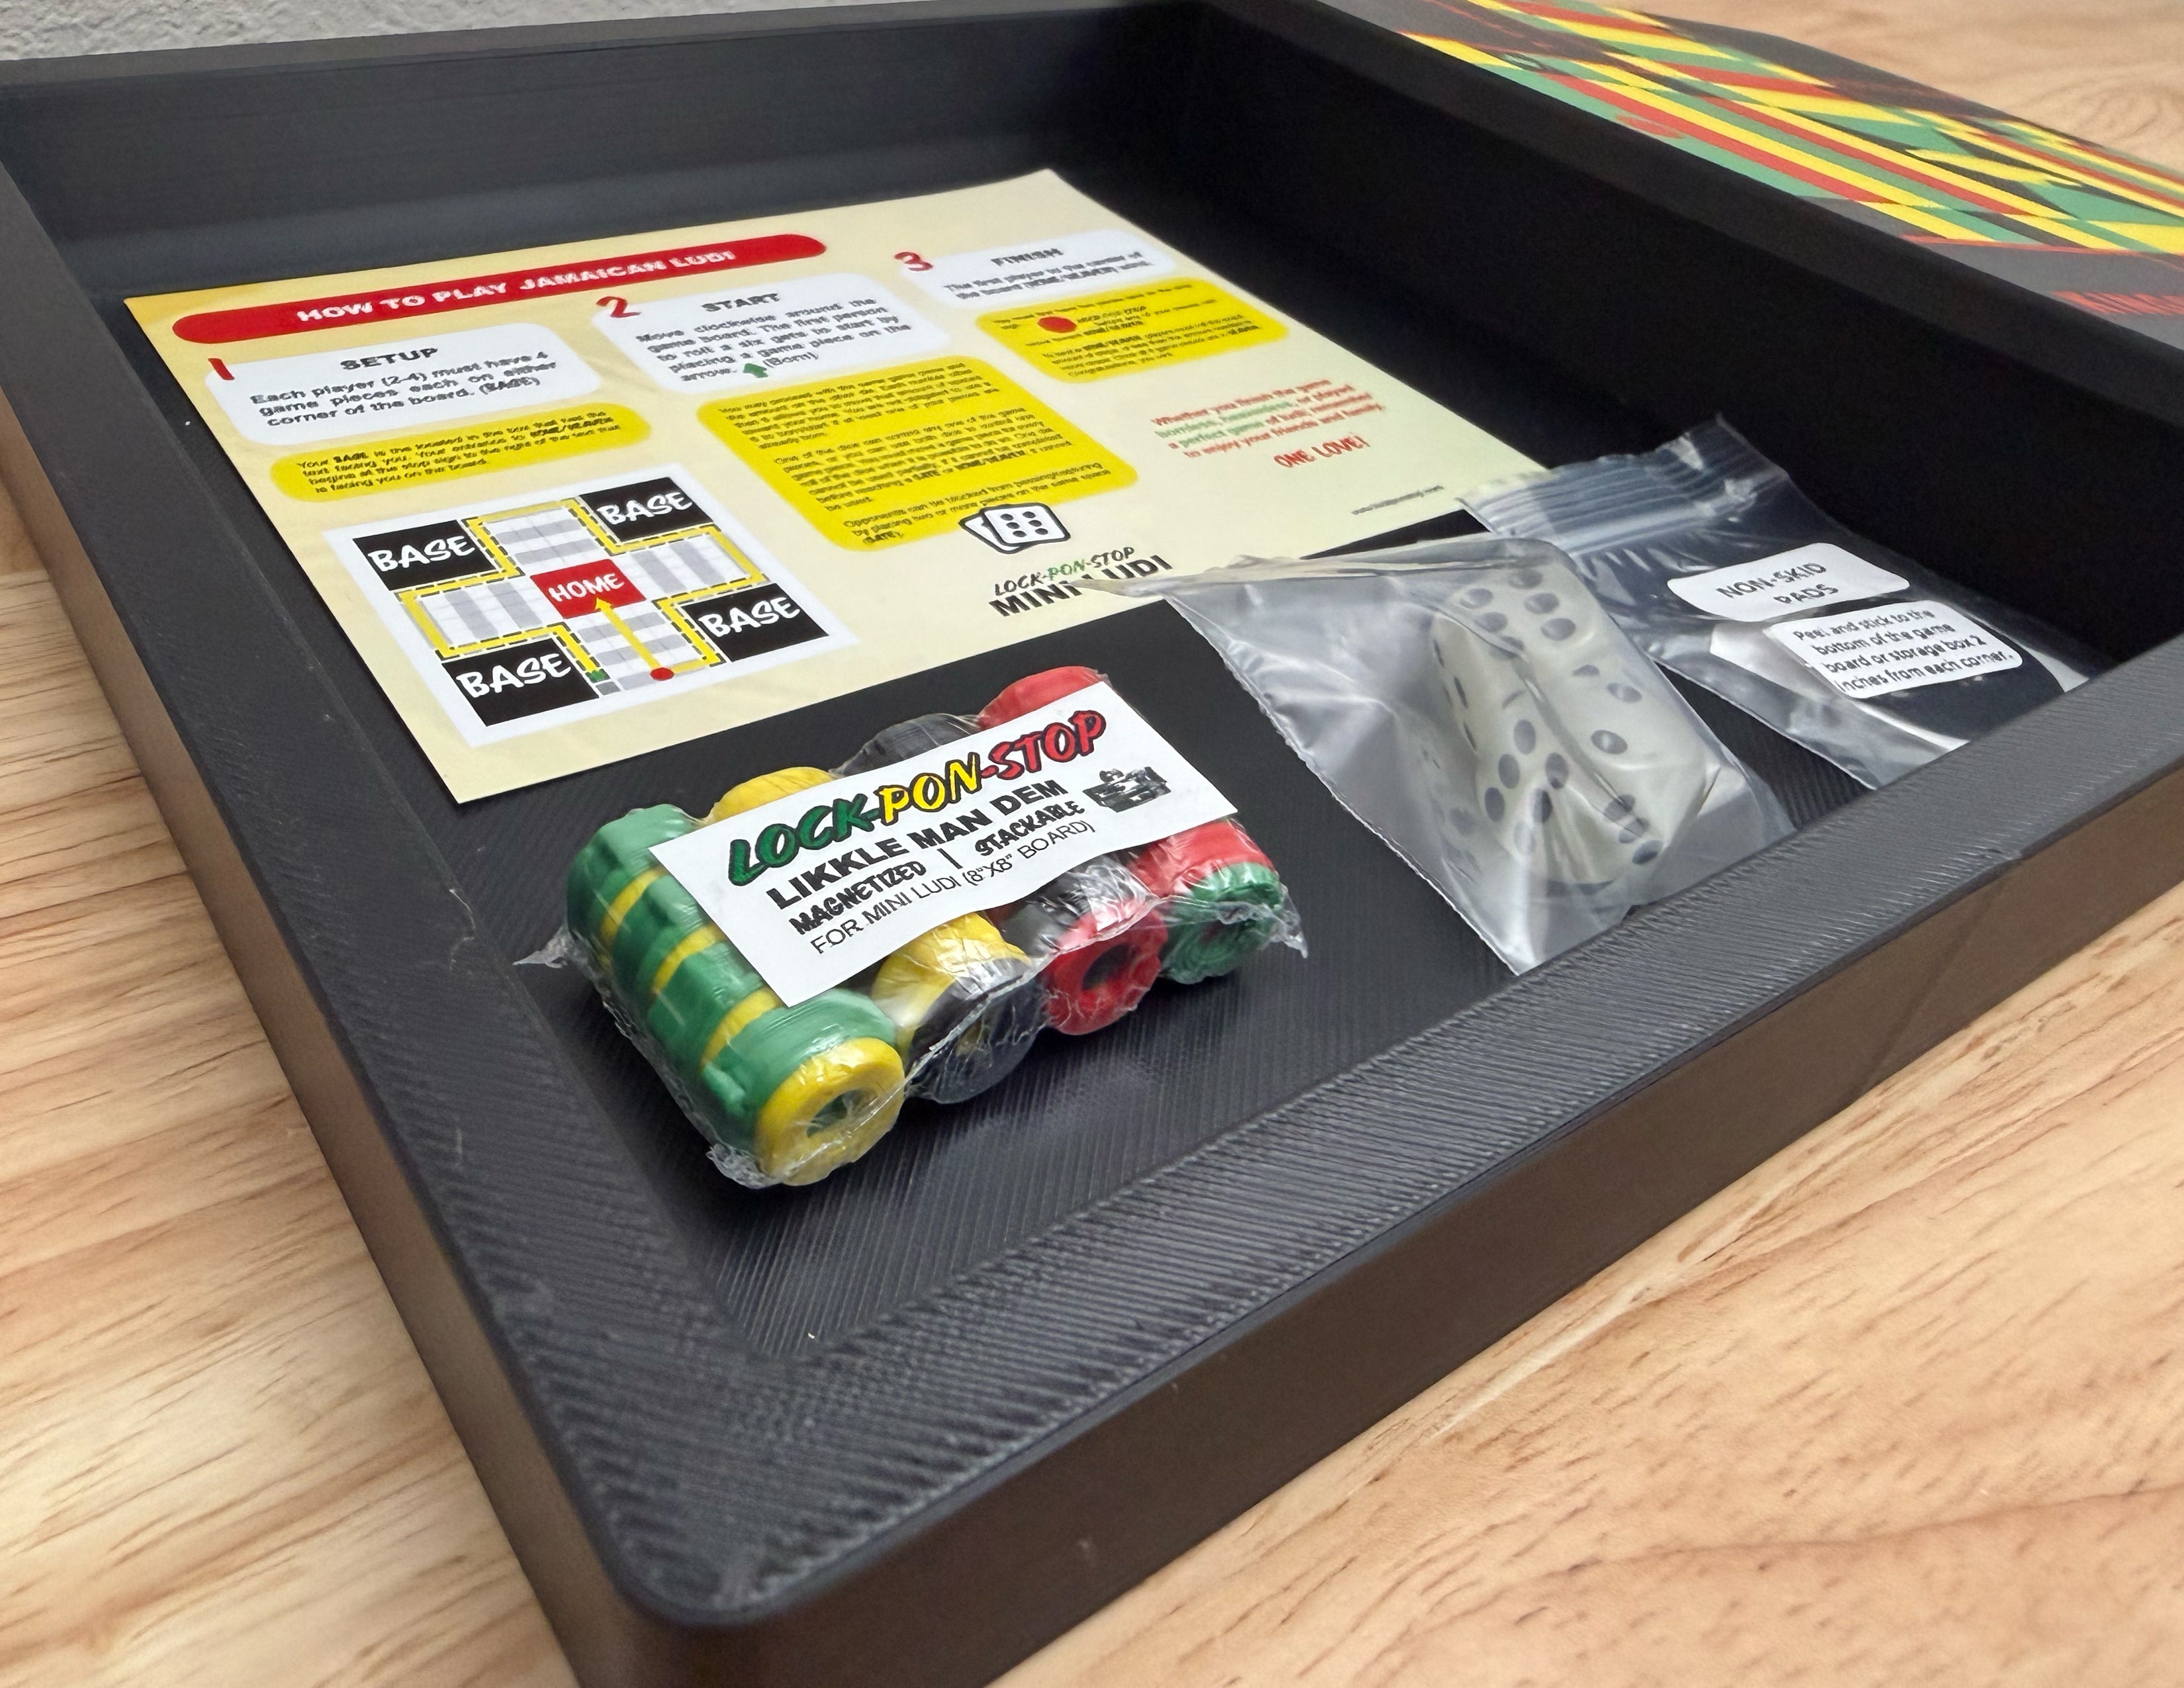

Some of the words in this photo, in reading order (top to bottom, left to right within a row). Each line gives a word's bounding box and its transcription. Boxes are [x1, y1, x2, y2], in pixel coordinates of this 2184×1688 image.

[894, 252, 933, 271] 3
[297, 302, 373, 321] HOW
[379, 295, 426, 309] TO
[432, 282, 506, 302] PLAY
[520, 260, 667, 290] JAMAICAN
[669, 251, 737, 267] LUDI
[702, 293, 780, 312] START
[596, 296, 641, 318] 2
[340, 348, 437, 370] SETUP
[250, 391, 306, 404] Each
[311, 381, 374, 398] player
[381, 373, 427, 387] (2-4)
[432, 363, 482, 377] must
[484, 355, 532, 368] have
[259, 401, 318, 416] game
[330, 390, 399, 407] pieces
[409, 379, 459, 392] each
[468, 373, 494, 383] on
[504, 362, 556, 377] either
[267, 410, 338, 426] corner
[344, 405, 365, 414] of
[370, 401, 404, 410] the
[408, 388, 475, 405] board.
[479, 377, 540, 395] (BASE)
[1274, 449, 1315, 467] ONE
[1311, 436, 1370, 457] LOVE!
[596, 489, 692, 526] BASE
[368, 533, 475, 572] BASE
[995, 547, 1134, 596] LOCK-PON-STOP
[549, 572, 625, 603] HOME
[989, 581, 1083, 616] MINI
[1082, 555, 1173, 580] UDI
[1716, 562, 1827, 598] NON-SKID
[1774, 584, 1839, 604] PADS
[699, 597, 800, 638] BASE
[1792, 628, 1831, 641] Peel
[1829, 622, 1860, 634] and
[1858, 616, 1893, 630] stick
[1890, 614, 1910, 623] to
[1907, 610, 1935, 620] the
[1810, 639, 1872, 655] bottom
[1869, 632, 1888, 645] of
[1885, 631, 1914, 641] the
[1912, 624, 1956, 639] game
[1821, 655, 1872, 673] board
[1870, 653, 1890, 664] or
[1888, 643, 1946, 661] storage
[1940, 638, 1976, 650] box
[1970, 635, 1987, 645] 2
[457, 653, 570, 698] BASE
[1884, 668, 1926, 682] from
[1923, 659, 1963, 675] each
[1959, 651, 2014, 667] corner.
[728, 710, 1107, 886] LOCK-PON-STOP
[766, 838, 910, 910] LIKKLE
[907, 808, 993, 849] MAN
[989, 780, 1069, 816] DEM
[789, 861, 927, 935] MAGNETIZED
[975, 800, 1085, 856] STACKABLE
[810, 919, 864, 954] FOR
[862, 892, 913, 925] MINI
[911, 876, 962, 899] LUDI
[1017, 820, 1096, 859] BOARD)
